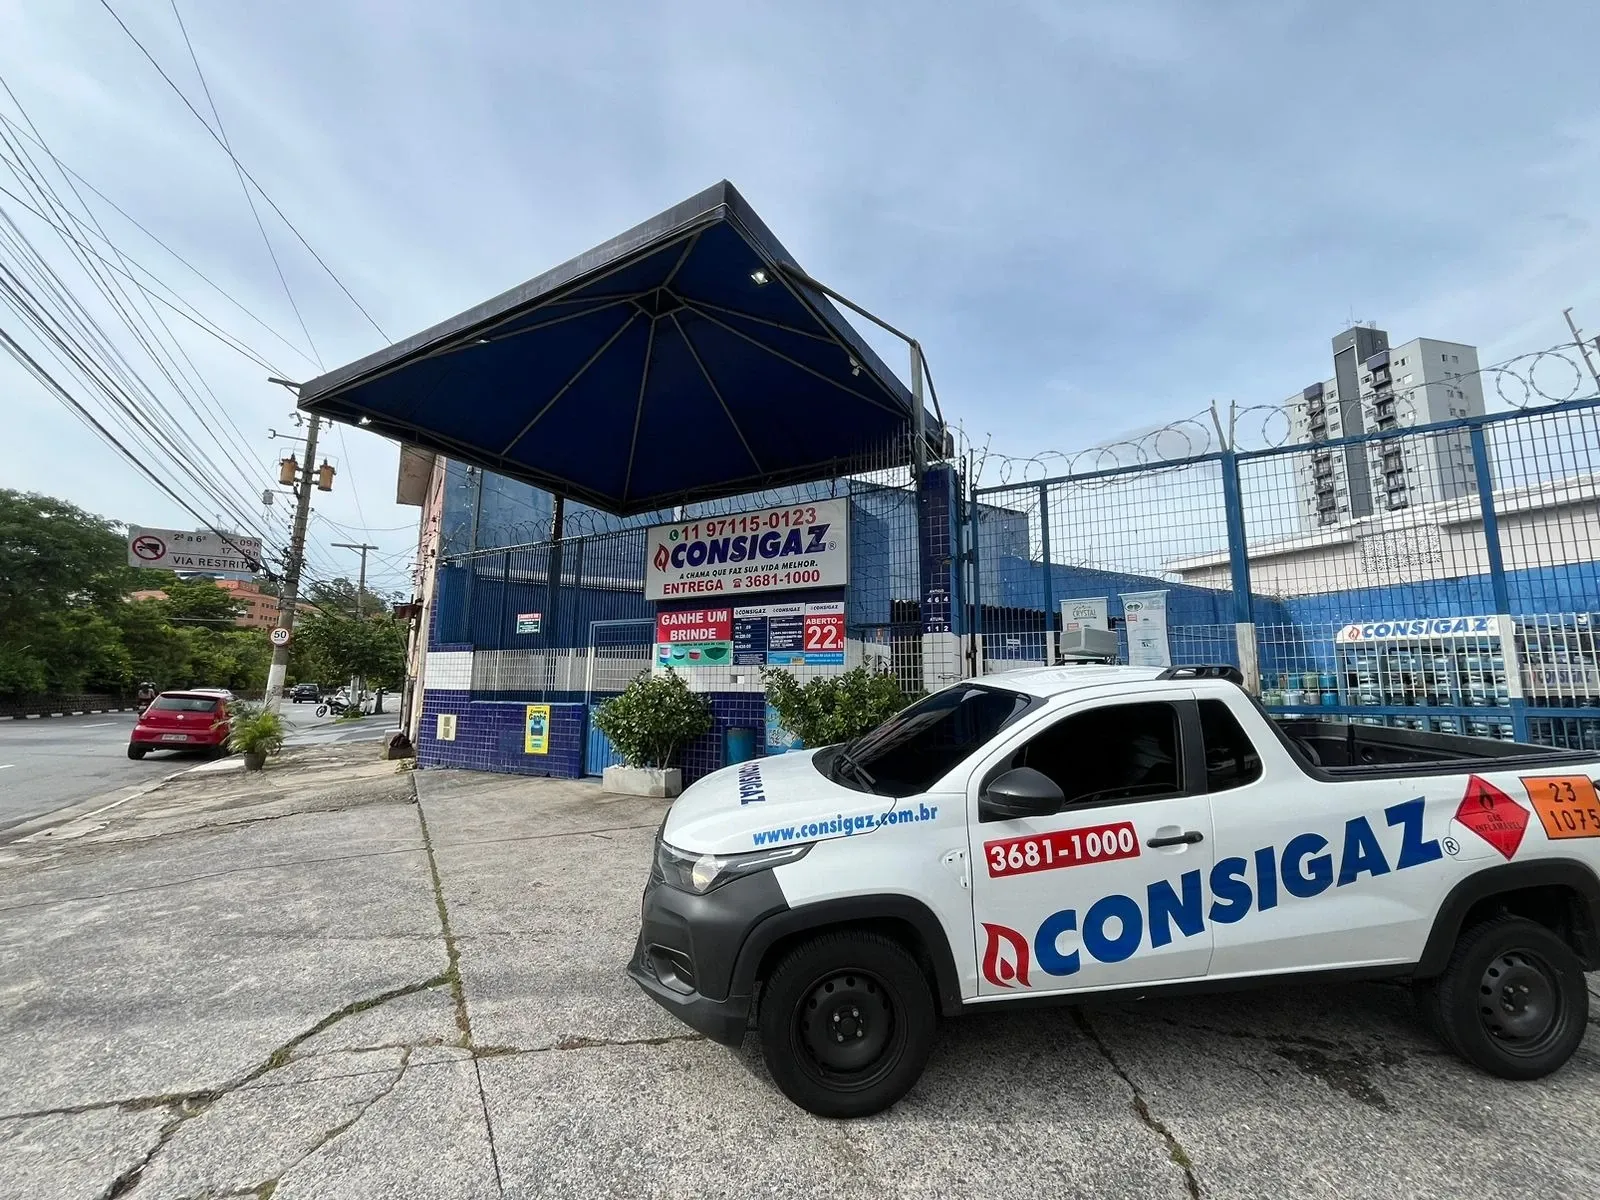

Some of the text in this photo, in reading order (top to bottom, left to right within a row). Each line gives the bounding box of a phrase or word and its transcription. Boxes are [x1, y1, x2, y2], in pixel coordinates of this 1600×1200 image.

[681, 507, 817, 541] 11 97115-0123
[671, 523, 831, 569] CONSIGAZ
[173, 555, 194, 565] VIA
[686, 571, 710, 579] CHAMA
[712, 568, 727, 577] QUE
[728, 567, 742, 575] FAZ
[743, 565, 759, 574] SUA
[760, 563, 779, 572] VIDA
[781, 559, 818, 570] MELHOR.
[663, 569, 820, 595] ENTREGA 3681-1000
[661, 610, 728, 626] GANHE UM
[806, 617, 837, 625] ABERTO
[1361, 615, 1492, 638] CONSIGAZ
[273, 630, 287, 639] 50
[670, 627, 717, 641] BRINDE
[807, 625, 838, 649] 22
[1548, 781, 1577, 803] 23
[752, 802, 938, 846] www.consigaz.com.br
[990, 826, 1135, 871] 3681-1000
[1033, 796, 1443, 977] CONSIGAZ
